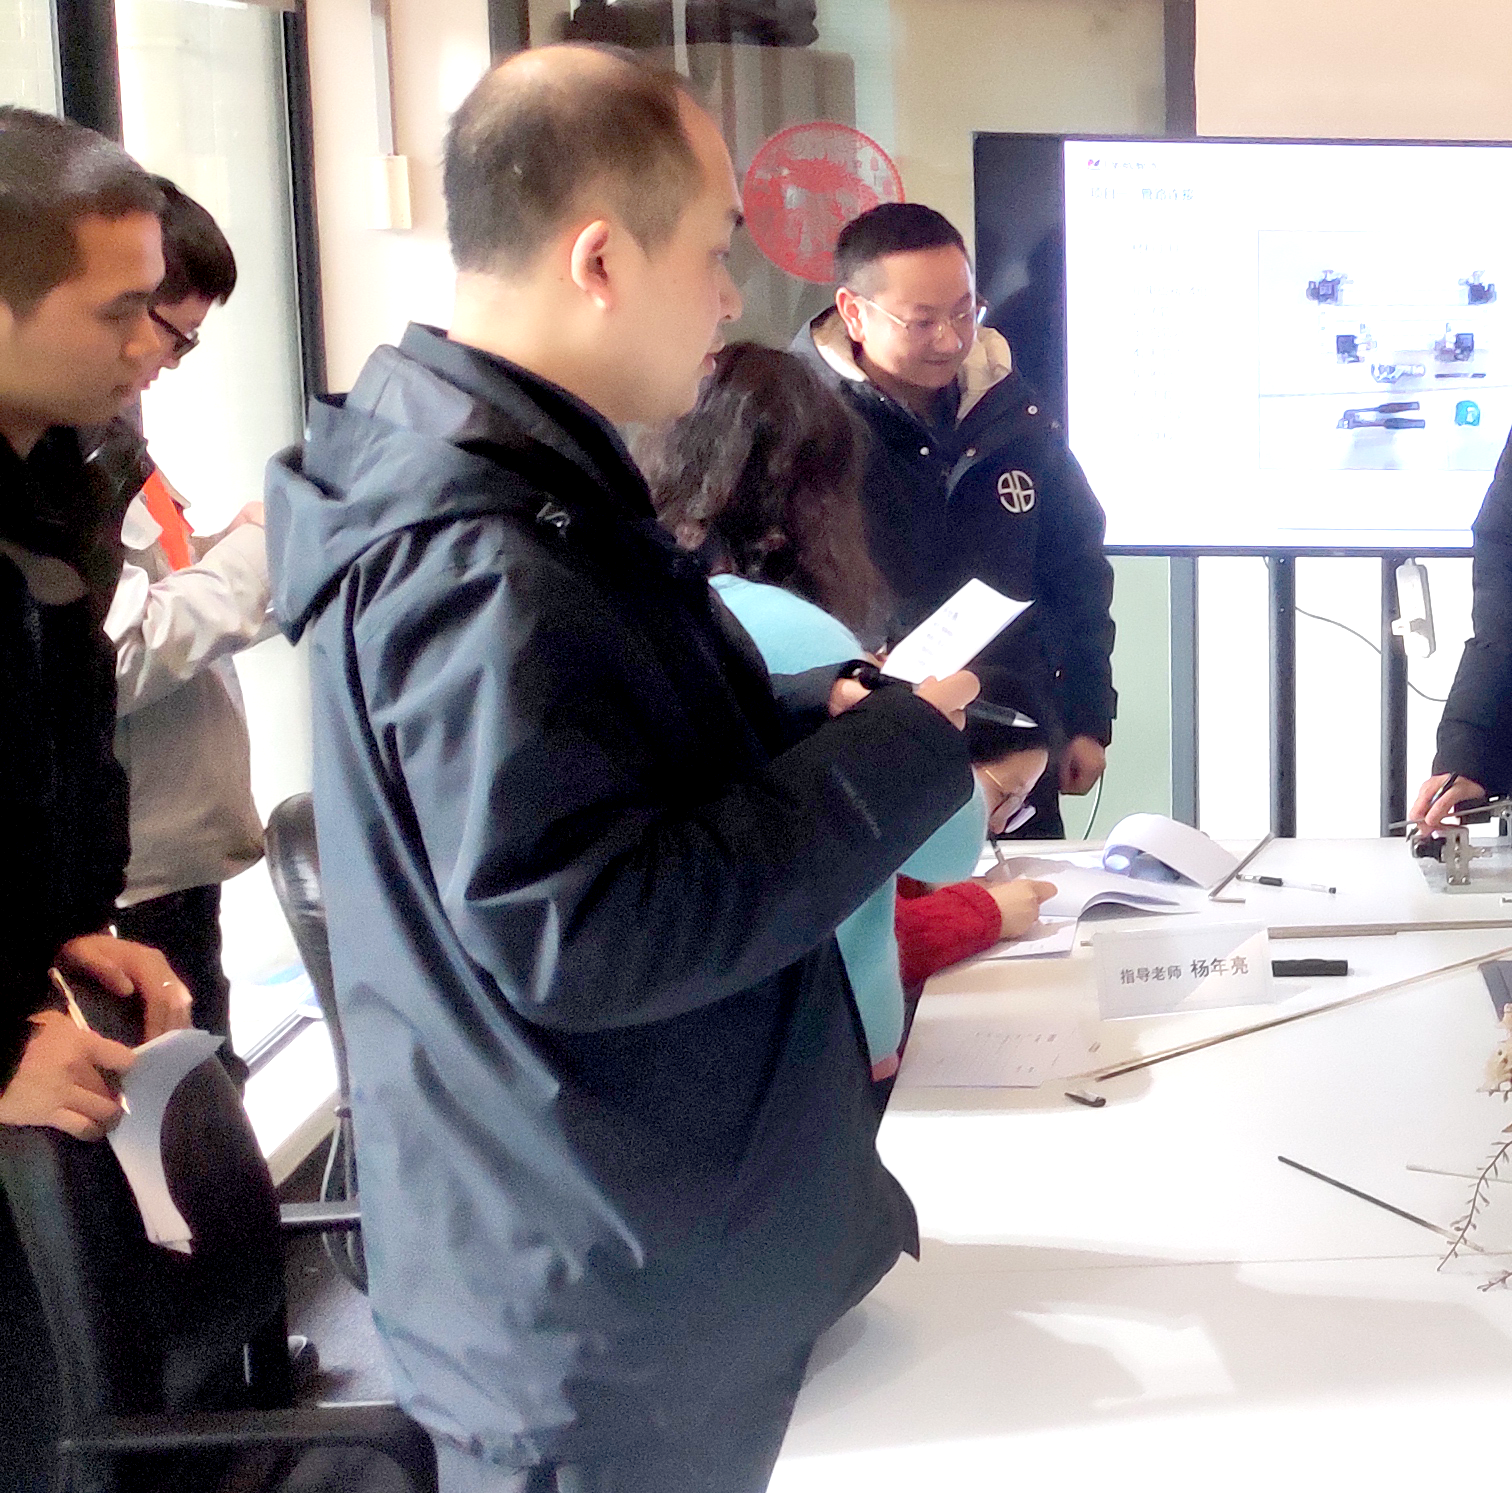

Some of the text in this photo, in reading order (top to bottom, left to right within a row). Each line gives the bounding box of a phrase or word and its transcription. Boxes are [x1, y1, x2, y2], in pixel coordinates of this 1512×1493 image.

[1120, 955, 1249, 984] 指导老师 杨年亮
